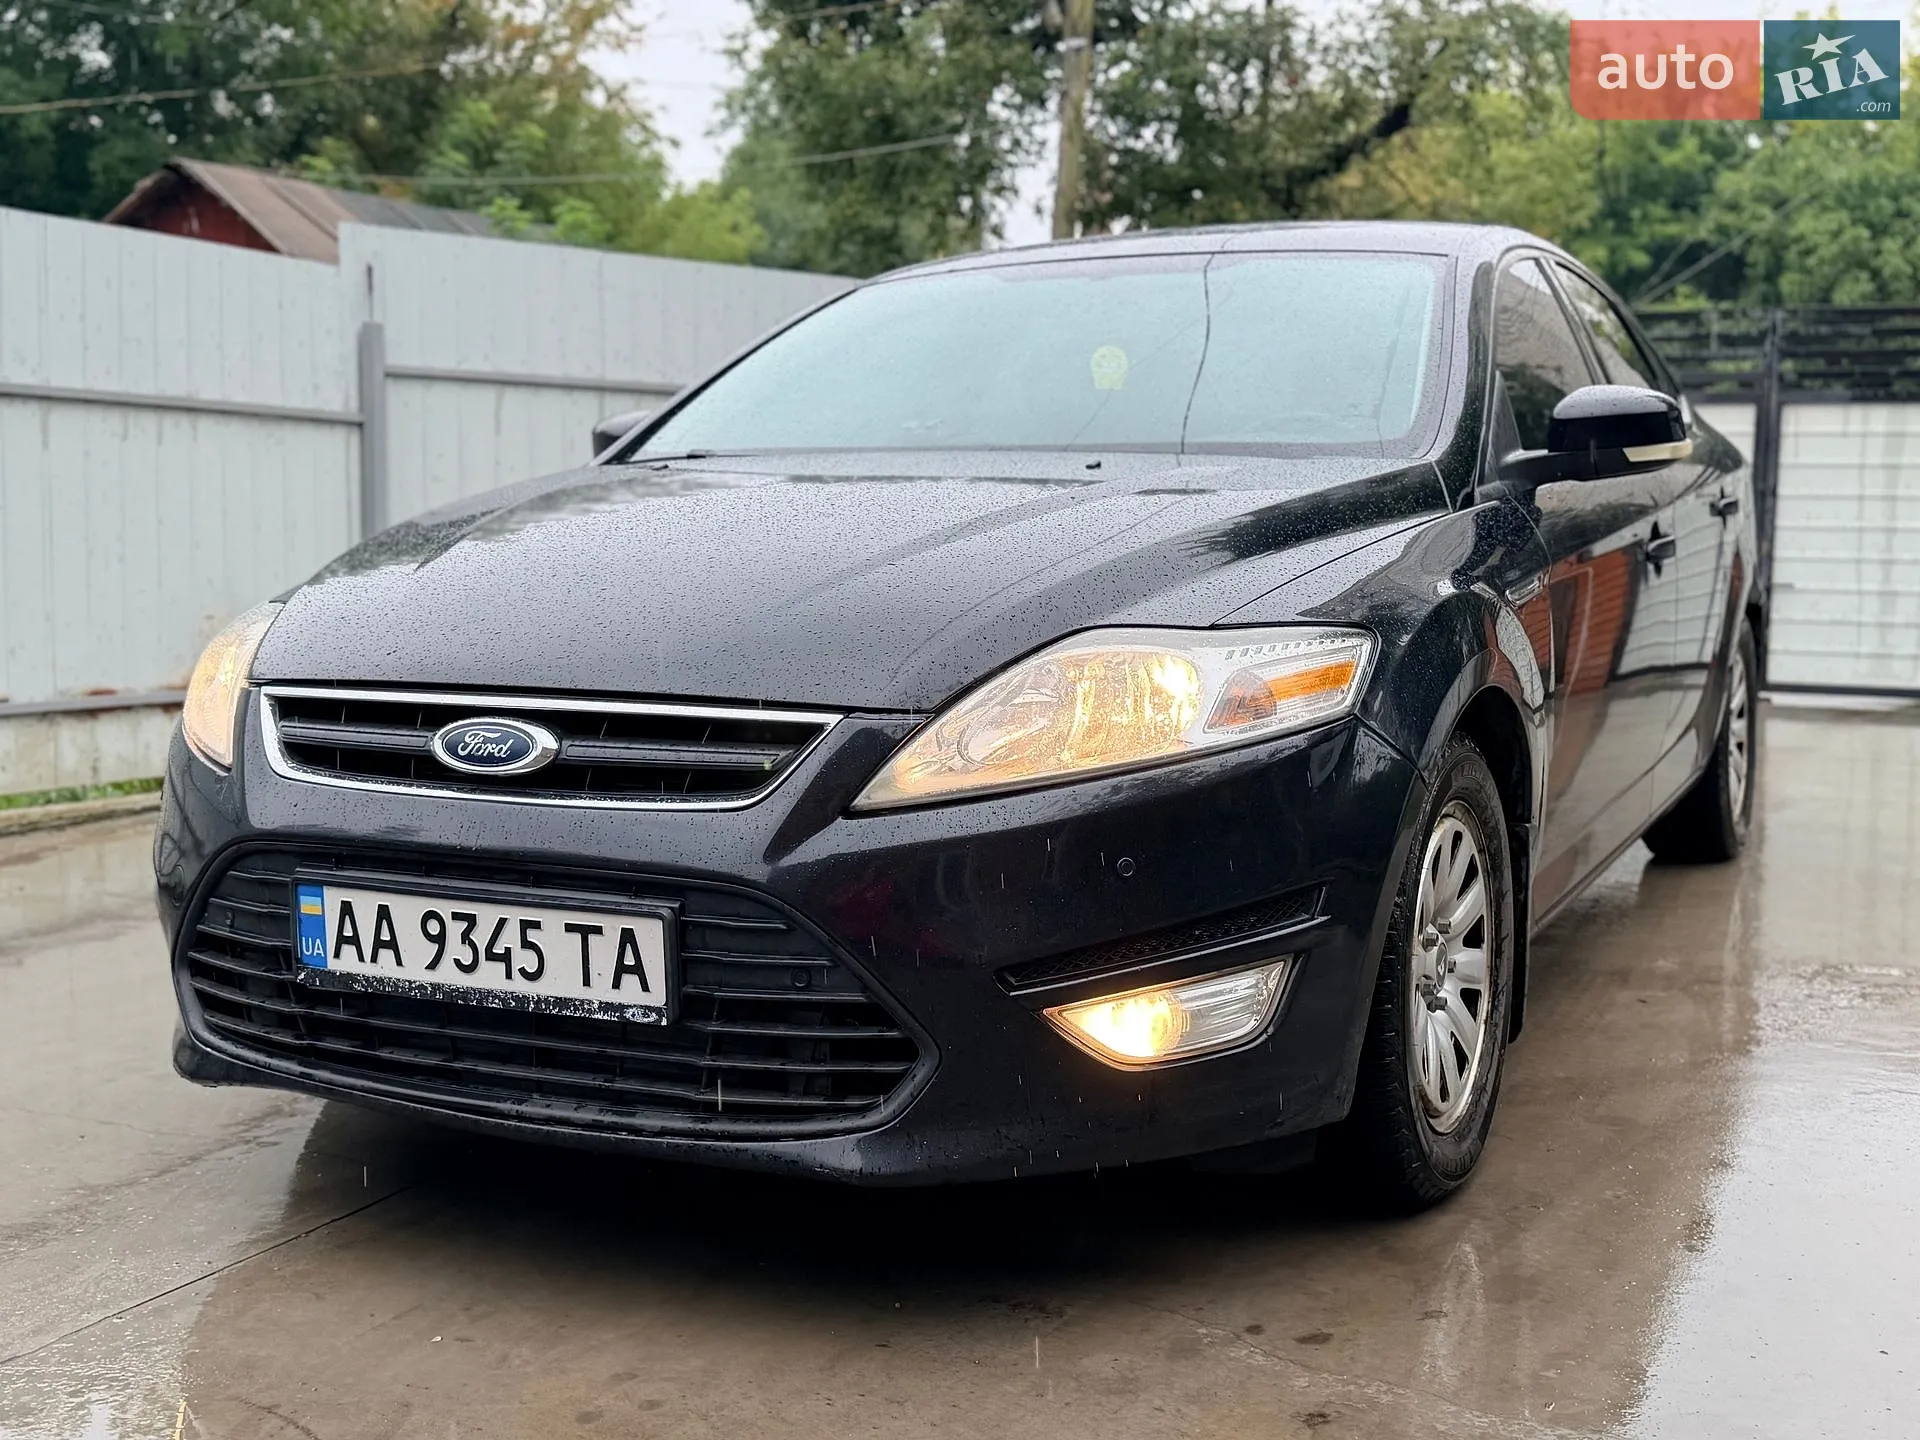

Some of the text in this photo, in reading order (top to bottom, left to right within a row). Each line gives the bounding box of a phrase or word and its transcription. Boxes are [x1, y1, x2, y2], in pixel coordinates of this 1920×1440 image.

[457, 730, 514, 758] Ford
[302, 936, 325, 958] UA
[332, 899, 651, 993] AA 9345 TA
